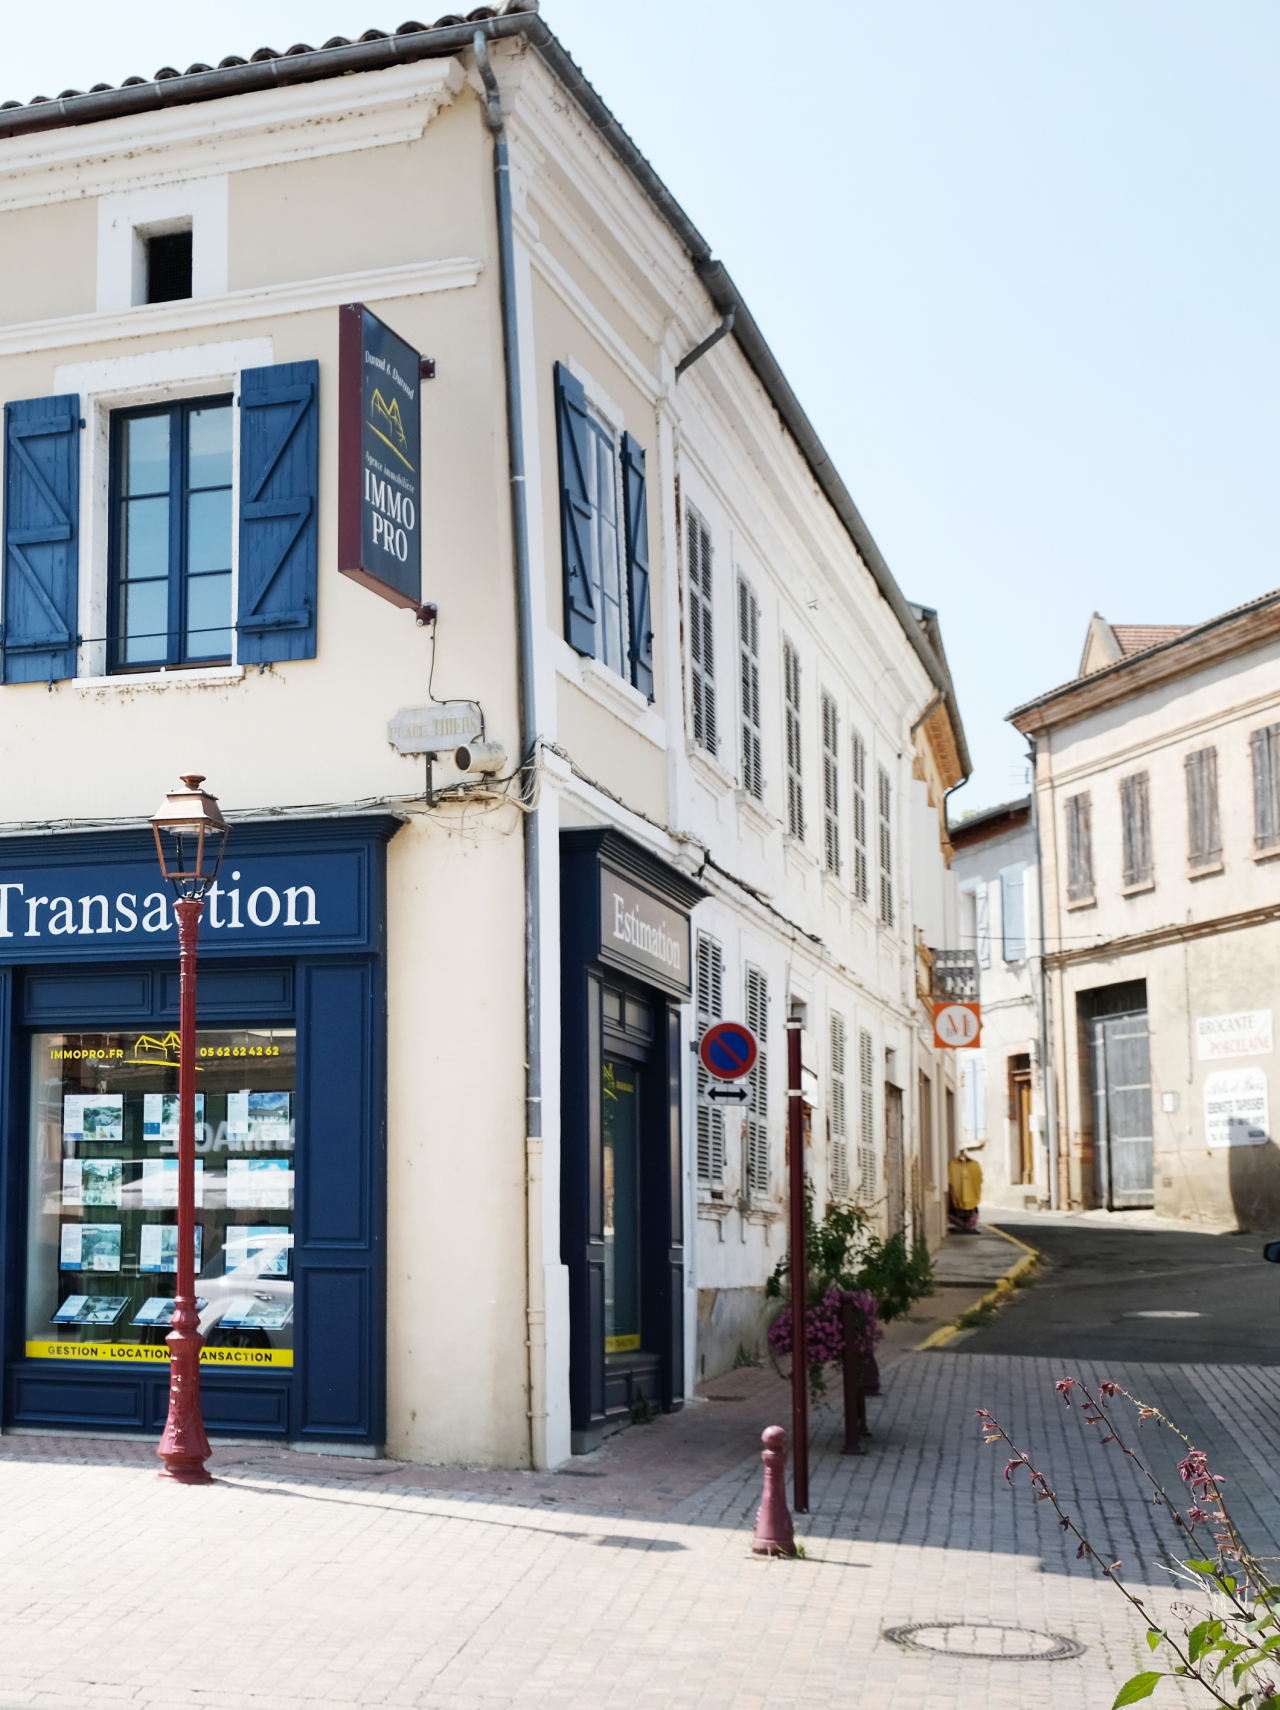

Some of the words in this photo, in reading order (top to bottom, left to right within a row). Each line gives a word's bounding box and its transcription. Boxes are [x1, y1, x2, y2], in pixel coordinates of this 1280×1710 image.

[392, 367, 415, 400] Durand
[365, 450, 383, 472] Agence
[364, 467, 415, 531] IMMO
[372, 510, 408, 562] PRO
[389, 724, 428, 739] PLACE
[433, 716, 478, 736] THIERS
[613, 892, 681, 970] Estimation
[1200, 1014, 1255, 1035] BROCANTE
[50, 1049, 124, 1060] IMMOPRO.FR
[199, 1047, 214, 1057] 05
[216, 1047, 231, 1057] 62
[232, 1047, 247, 1057] 62
[248, 1046, 264, 1056] 42
[265, 1046, 280, 1056] 62
[1210, 1036, 1270, 1055] PORCELAINE
[48, 1345, 98, 1357] GESTION
[110, 1347, 171, 1359] LOCATION
[200, 1350, 273, 1363] ANSACTION
